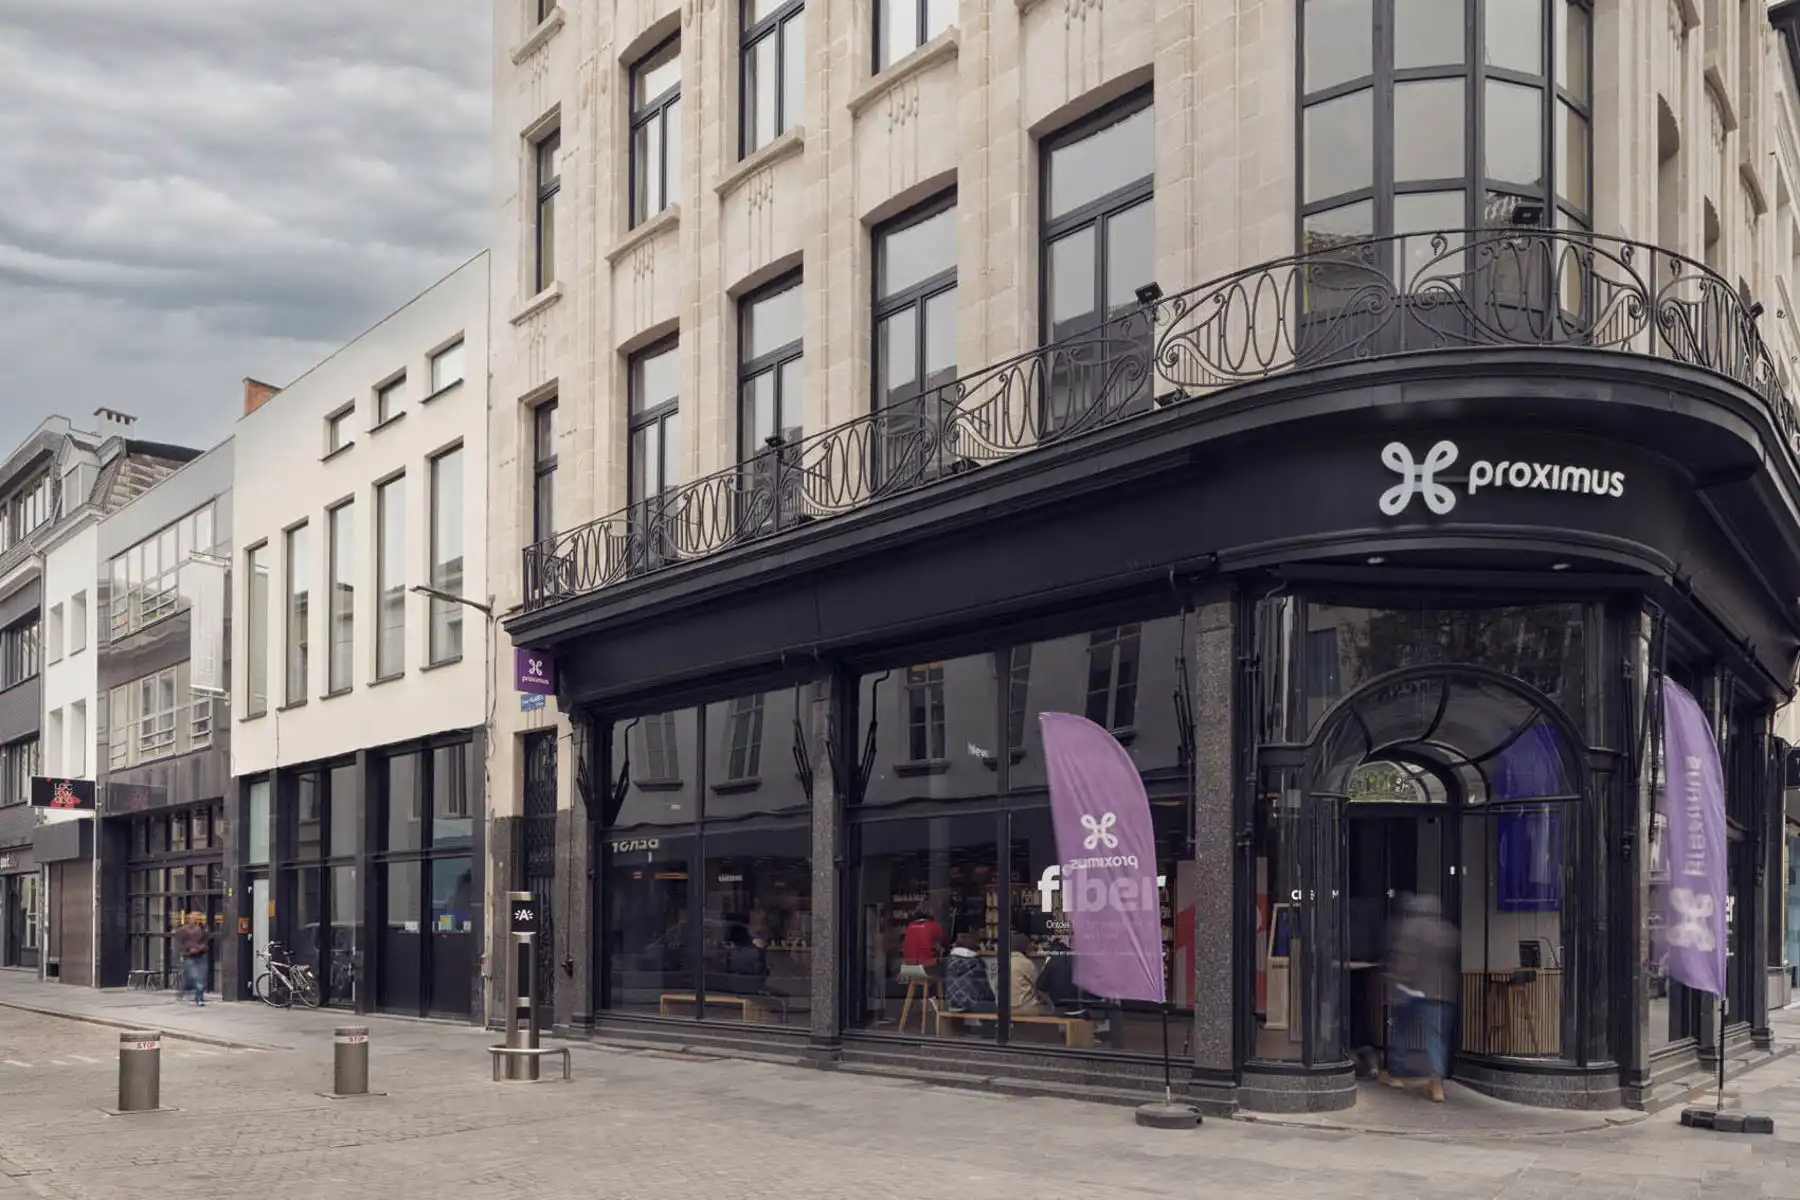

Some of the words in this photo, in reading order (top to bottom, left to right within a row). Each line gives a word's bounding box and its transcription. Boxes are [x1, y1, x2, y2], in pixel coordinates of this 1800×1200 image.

[1468, 460, 1625, 498] proximus
[521, 676, 550, 685] proximus
[1037, 865, 1167, 912] fiber
